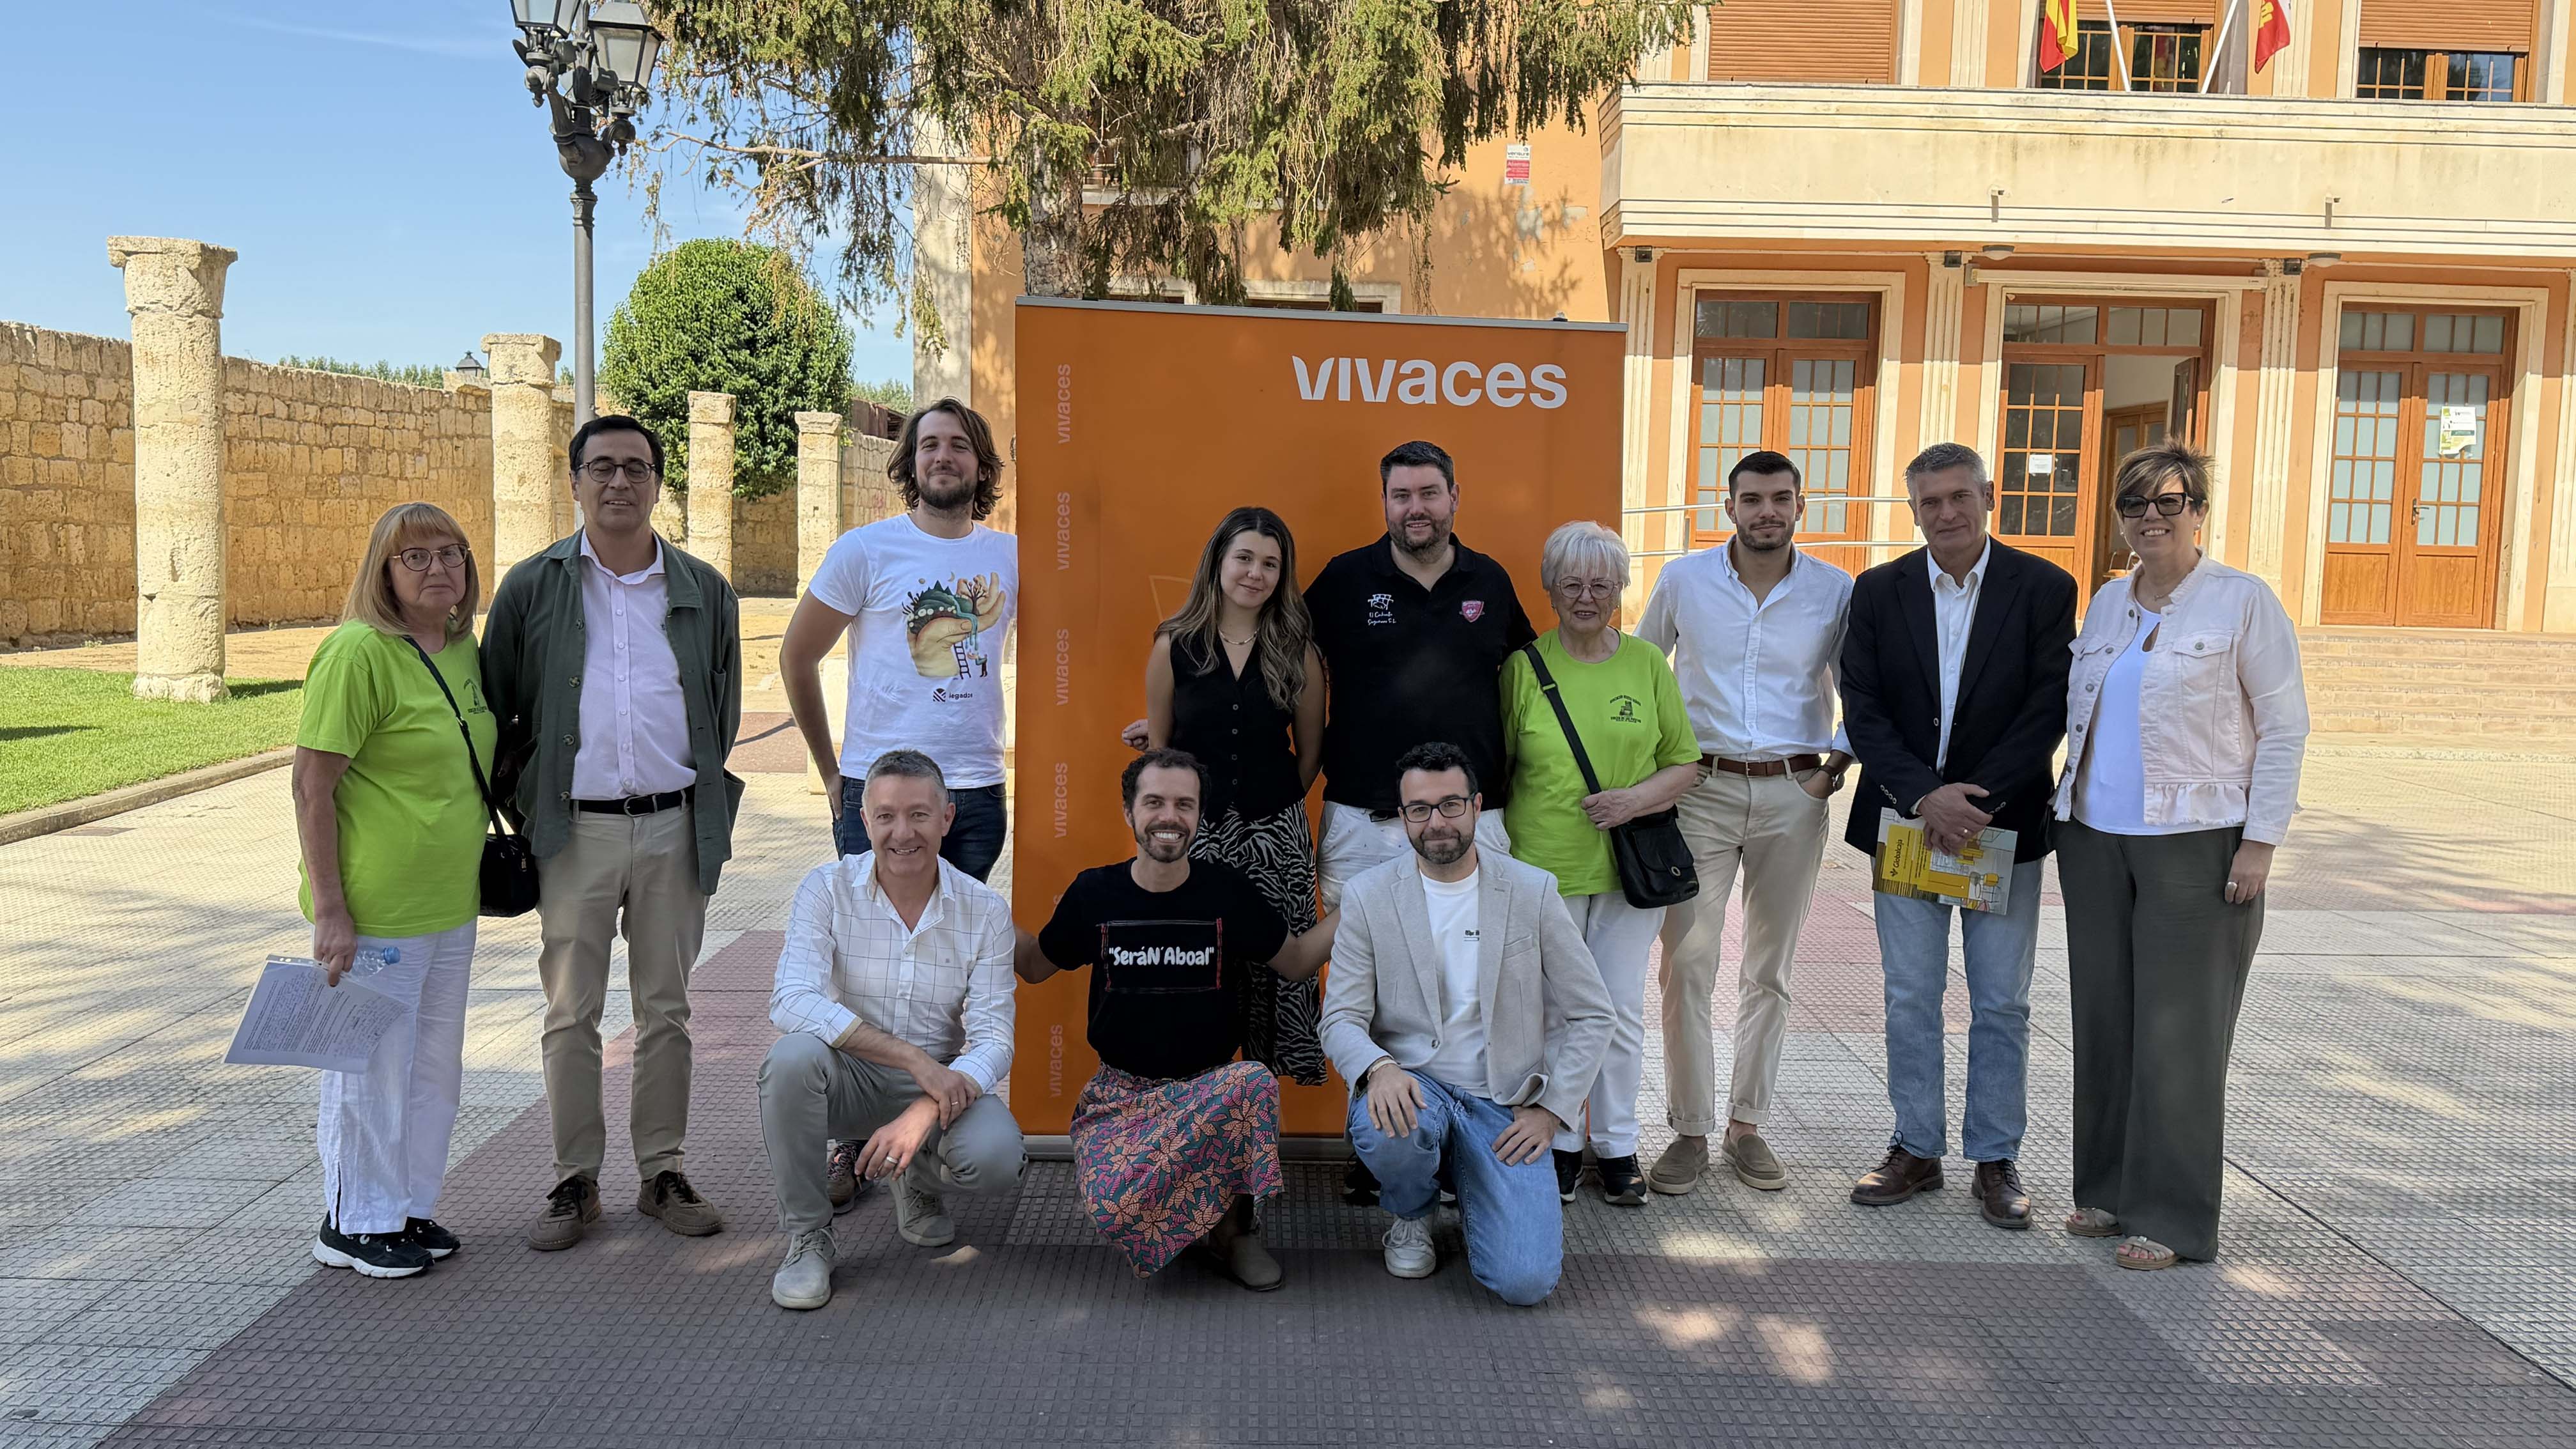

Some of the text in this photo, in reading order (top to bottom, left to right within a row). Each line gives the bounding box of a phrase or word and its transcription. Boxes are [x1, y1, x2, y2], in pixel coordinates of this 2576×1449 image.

[1058, 364, 1070, 444] vivaces
[1057, 492, 1070, 570] vivaces
[1056, 628, 1069, 706] vivaces
[1054, 762, 1068, 838] vivaces
[1893, 839, 1904, 868] Globalcaja
[1049, 1024, 1063, 1098] vivaces
